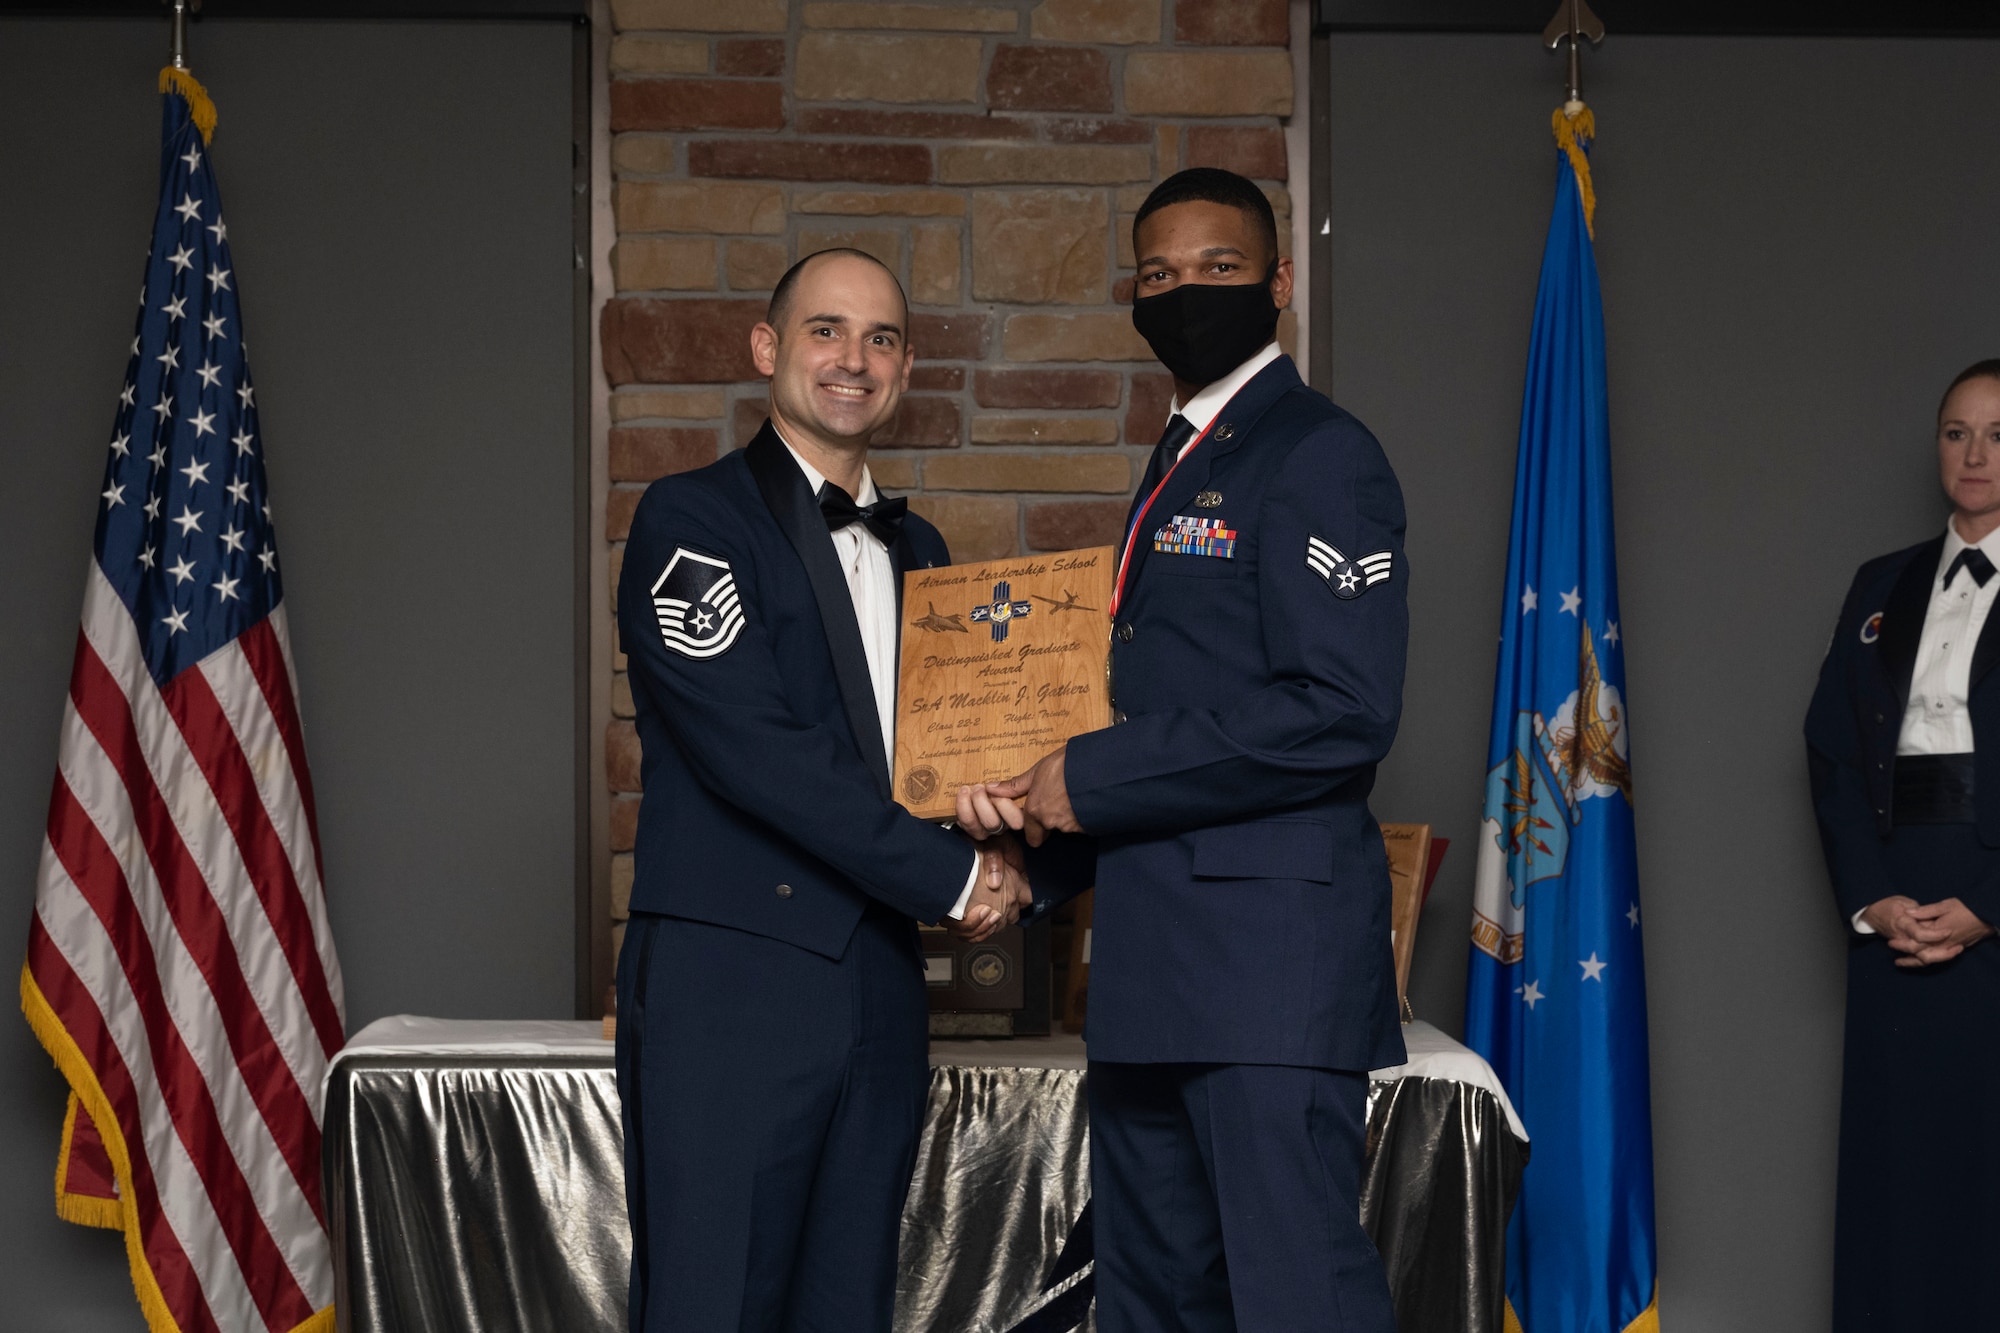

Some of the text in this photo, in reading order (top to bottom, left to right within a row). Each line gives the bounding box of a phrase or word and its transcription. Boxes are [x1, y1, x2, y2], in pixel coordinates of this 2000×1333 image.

[915, 555, 1098, 590] Airman Leadership School
[923, 640, 1081, 669] Distinguished Graduate
[976, 661, 1024, 678] Award
[910, 681, 1090, 714] SrA Macklin J. Gathers
[927, 717, 981, 733] Class 22-2
[1003, 712, 1035, 724] Flight:
[944, 727, 1054, 746] For demonstrating superior
[917, 747, 962, 759] Leadership
[967, 746, 980, 754] and
[983, 741, 1025, 752] Academic
[1472, 920, 1500, 952] AIR
